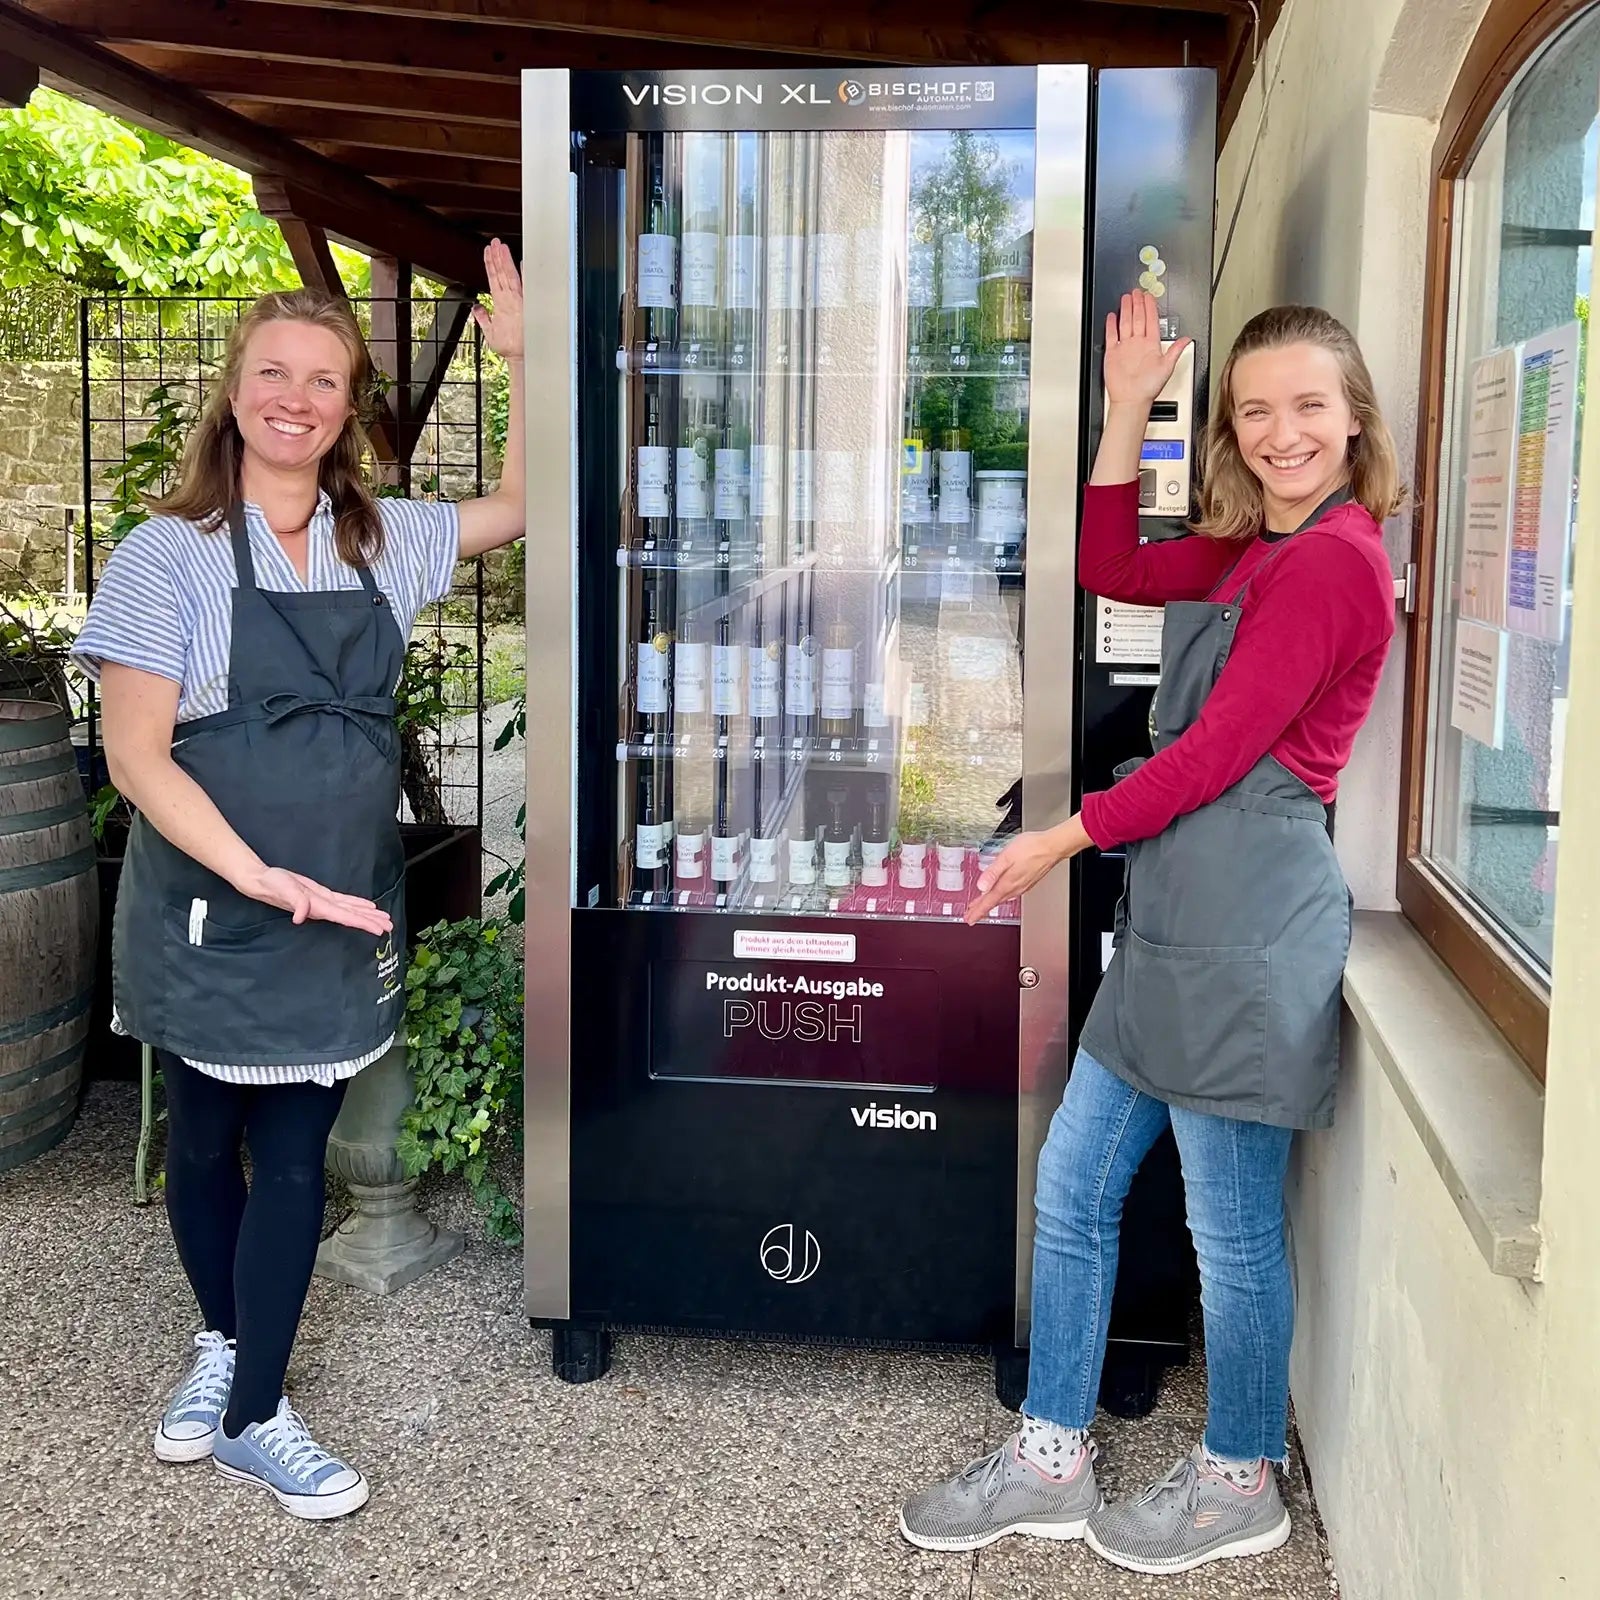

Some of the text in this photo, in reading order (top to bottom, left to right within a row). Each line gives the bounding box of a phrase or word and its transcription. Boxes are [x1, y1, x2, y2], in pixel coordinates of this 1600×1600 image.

[868, 82, 972, 96] BISCHOF
[622, 83, 831, 106] VISION XL
[916, 95, 972, 103] AUTOMATEN
[645, 353, 657, 363] 41
[685, 353, 698, 364] 42
[731, 354, 744, 365] 43
[953, 355, 966, 366] 48
[1001, 354, 1014, 365] 49
[641, 552, 653, 562] 31
[677, 552, 689, 562] 32
[716, 553, 729, 564] 33
[993, 557, 1007, 568] 99
[641, 747, 653, 756] 21
[675, 747, 688, 757] 22
[712, 748, 725, 758] 23
[753, 749, 766, 760] 24
[790, 750, 803, 760] 25
[829, 751, 841, 761] 26
[867, 752, 879, 762] 27
[740, 935, 770, 944] Produkt
[786, 937, 804, 945] dem
[772, 946, 795, 954] gleich
[706, 972, 884, 1000] Produkt-Ausgabe
[723, 999, 862, 1043] PUSH
[850, 1102, 937, 1131] vision
